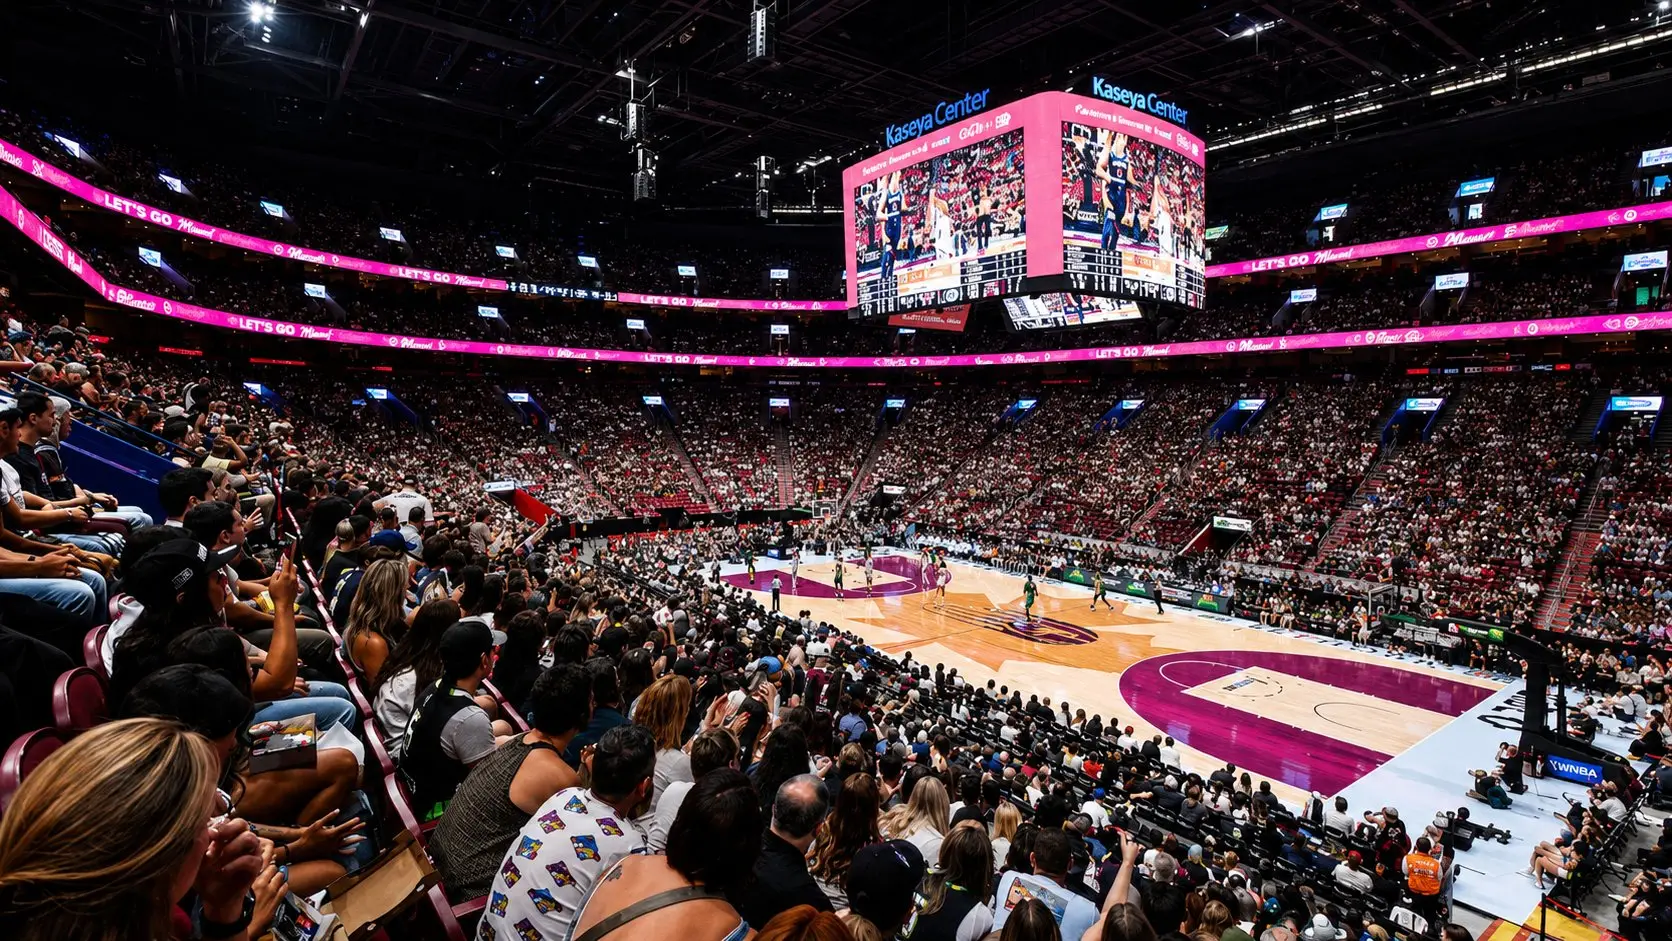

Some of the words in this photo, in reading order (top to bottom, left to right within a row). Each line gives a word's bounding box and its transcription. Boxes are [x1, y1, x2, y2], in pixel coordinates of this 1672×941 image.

[1093, 76, 1146, 112] Kaseya
[1147, 93, 1188, 125] Center
[885, 112, 933, 149] Kaseya
[935, 88, 990, 125] Center
[104, 194, 147, 218] LET'S
[150, 210, 172, 226] GO
[1251, 258, 1285, 272] LET'S
[1288, 255, 1309, 267] GO
[398, 267, 431, 280] LET'S
[433, 272, 451, 283] GO
[671, 297, 687, 306] GO
[239, 317, 273, 332] LET'S
[275, 323, 295, 335] GO
